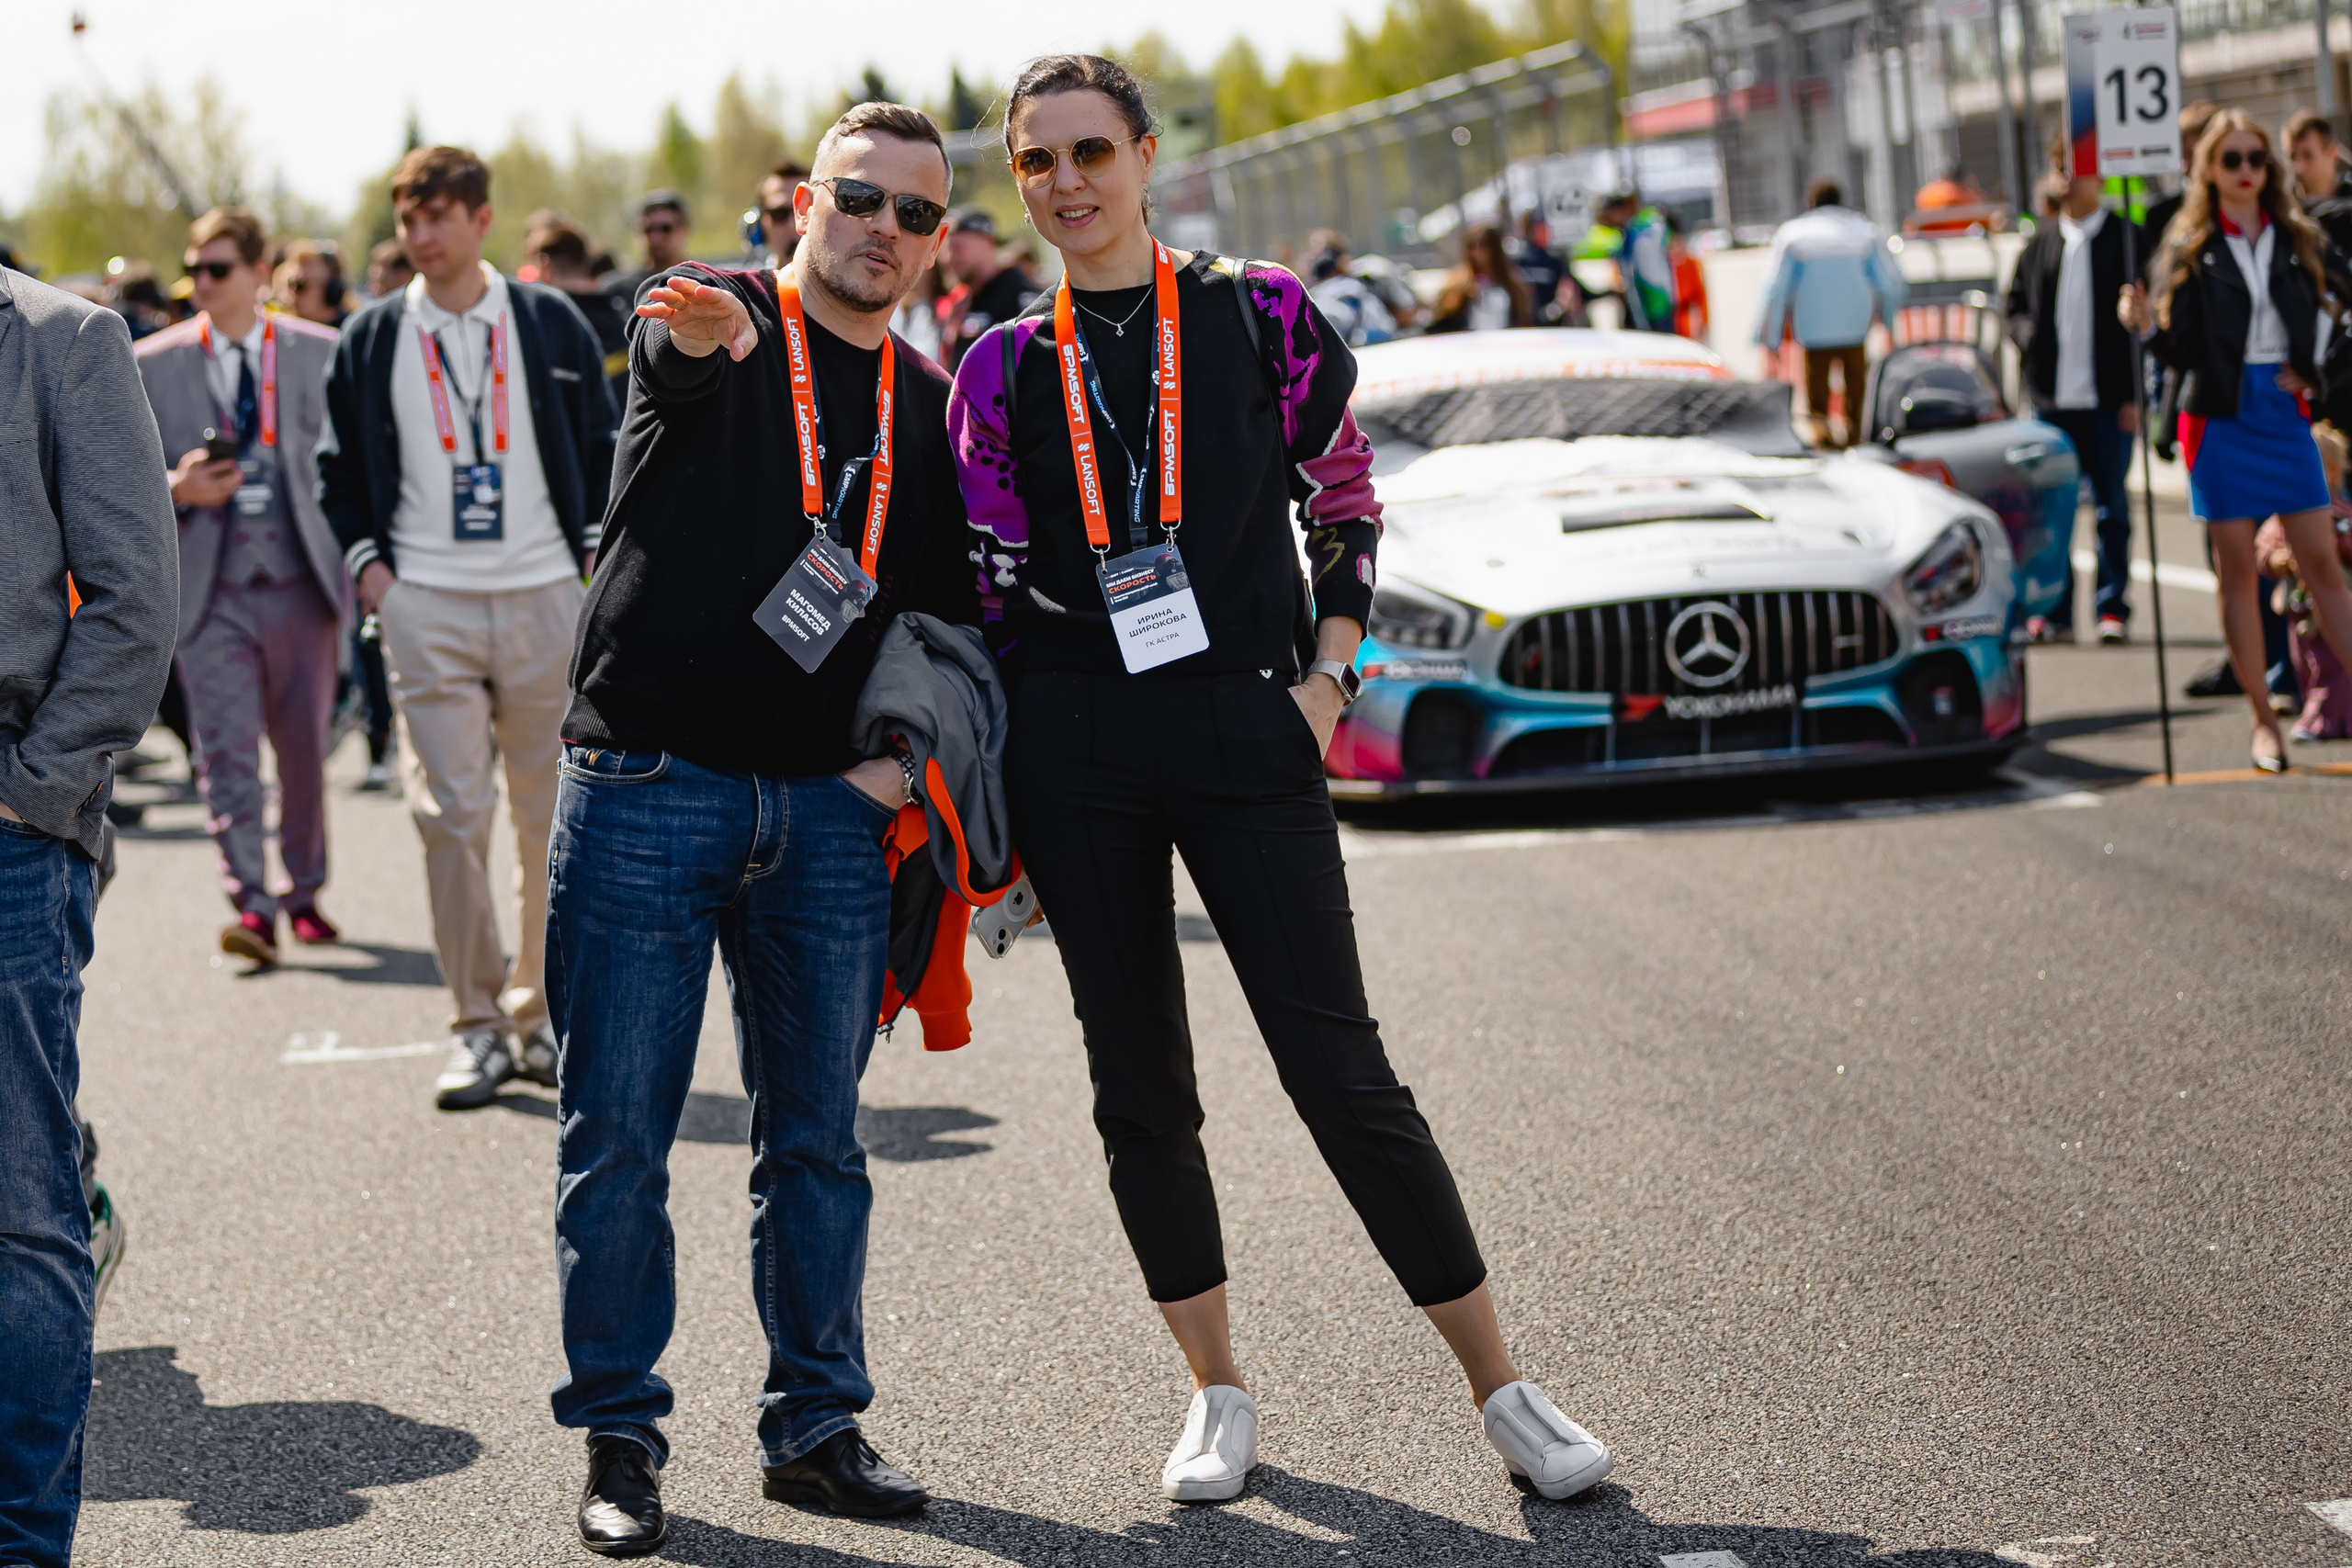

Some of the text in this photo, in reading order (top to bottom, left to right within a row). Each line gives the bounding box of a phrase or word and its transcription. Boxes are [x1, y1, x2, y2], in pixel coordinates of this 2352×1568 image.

[2104, 64, 2169, 126] 13
[786, 317, 805, 371] LANSOFT
[1162, 317, 1174, 378] LANSOFT
[1063, 344, 1085, 423] BPMSOFT
[797, 400, 816, 487] BPMSOFT
[879, 389, 891, 467] BPMSOFT
[1164, 410, 1175, 496] BPMSOFT
[1081, 454, 1101, 516] LANSOFT
[866, 494, 887, 555] LANSOFT
[807, 553, 843, 590] СКОРОСТЬ
[1108, 573, 1157, 594] СКОРОСТЬ
[781, 615, 810, 642] BPMSOFT
[786, 597, 825, 636] КИЛАСОВ
[790, 588, 831, 631] МАГОМЕД
[1129, 613, 1187, 638] ШИРОКОВА
[1137, 608, 1173, 625] ИРИНА
[1156, 632, 1180, 644] АСТРА
